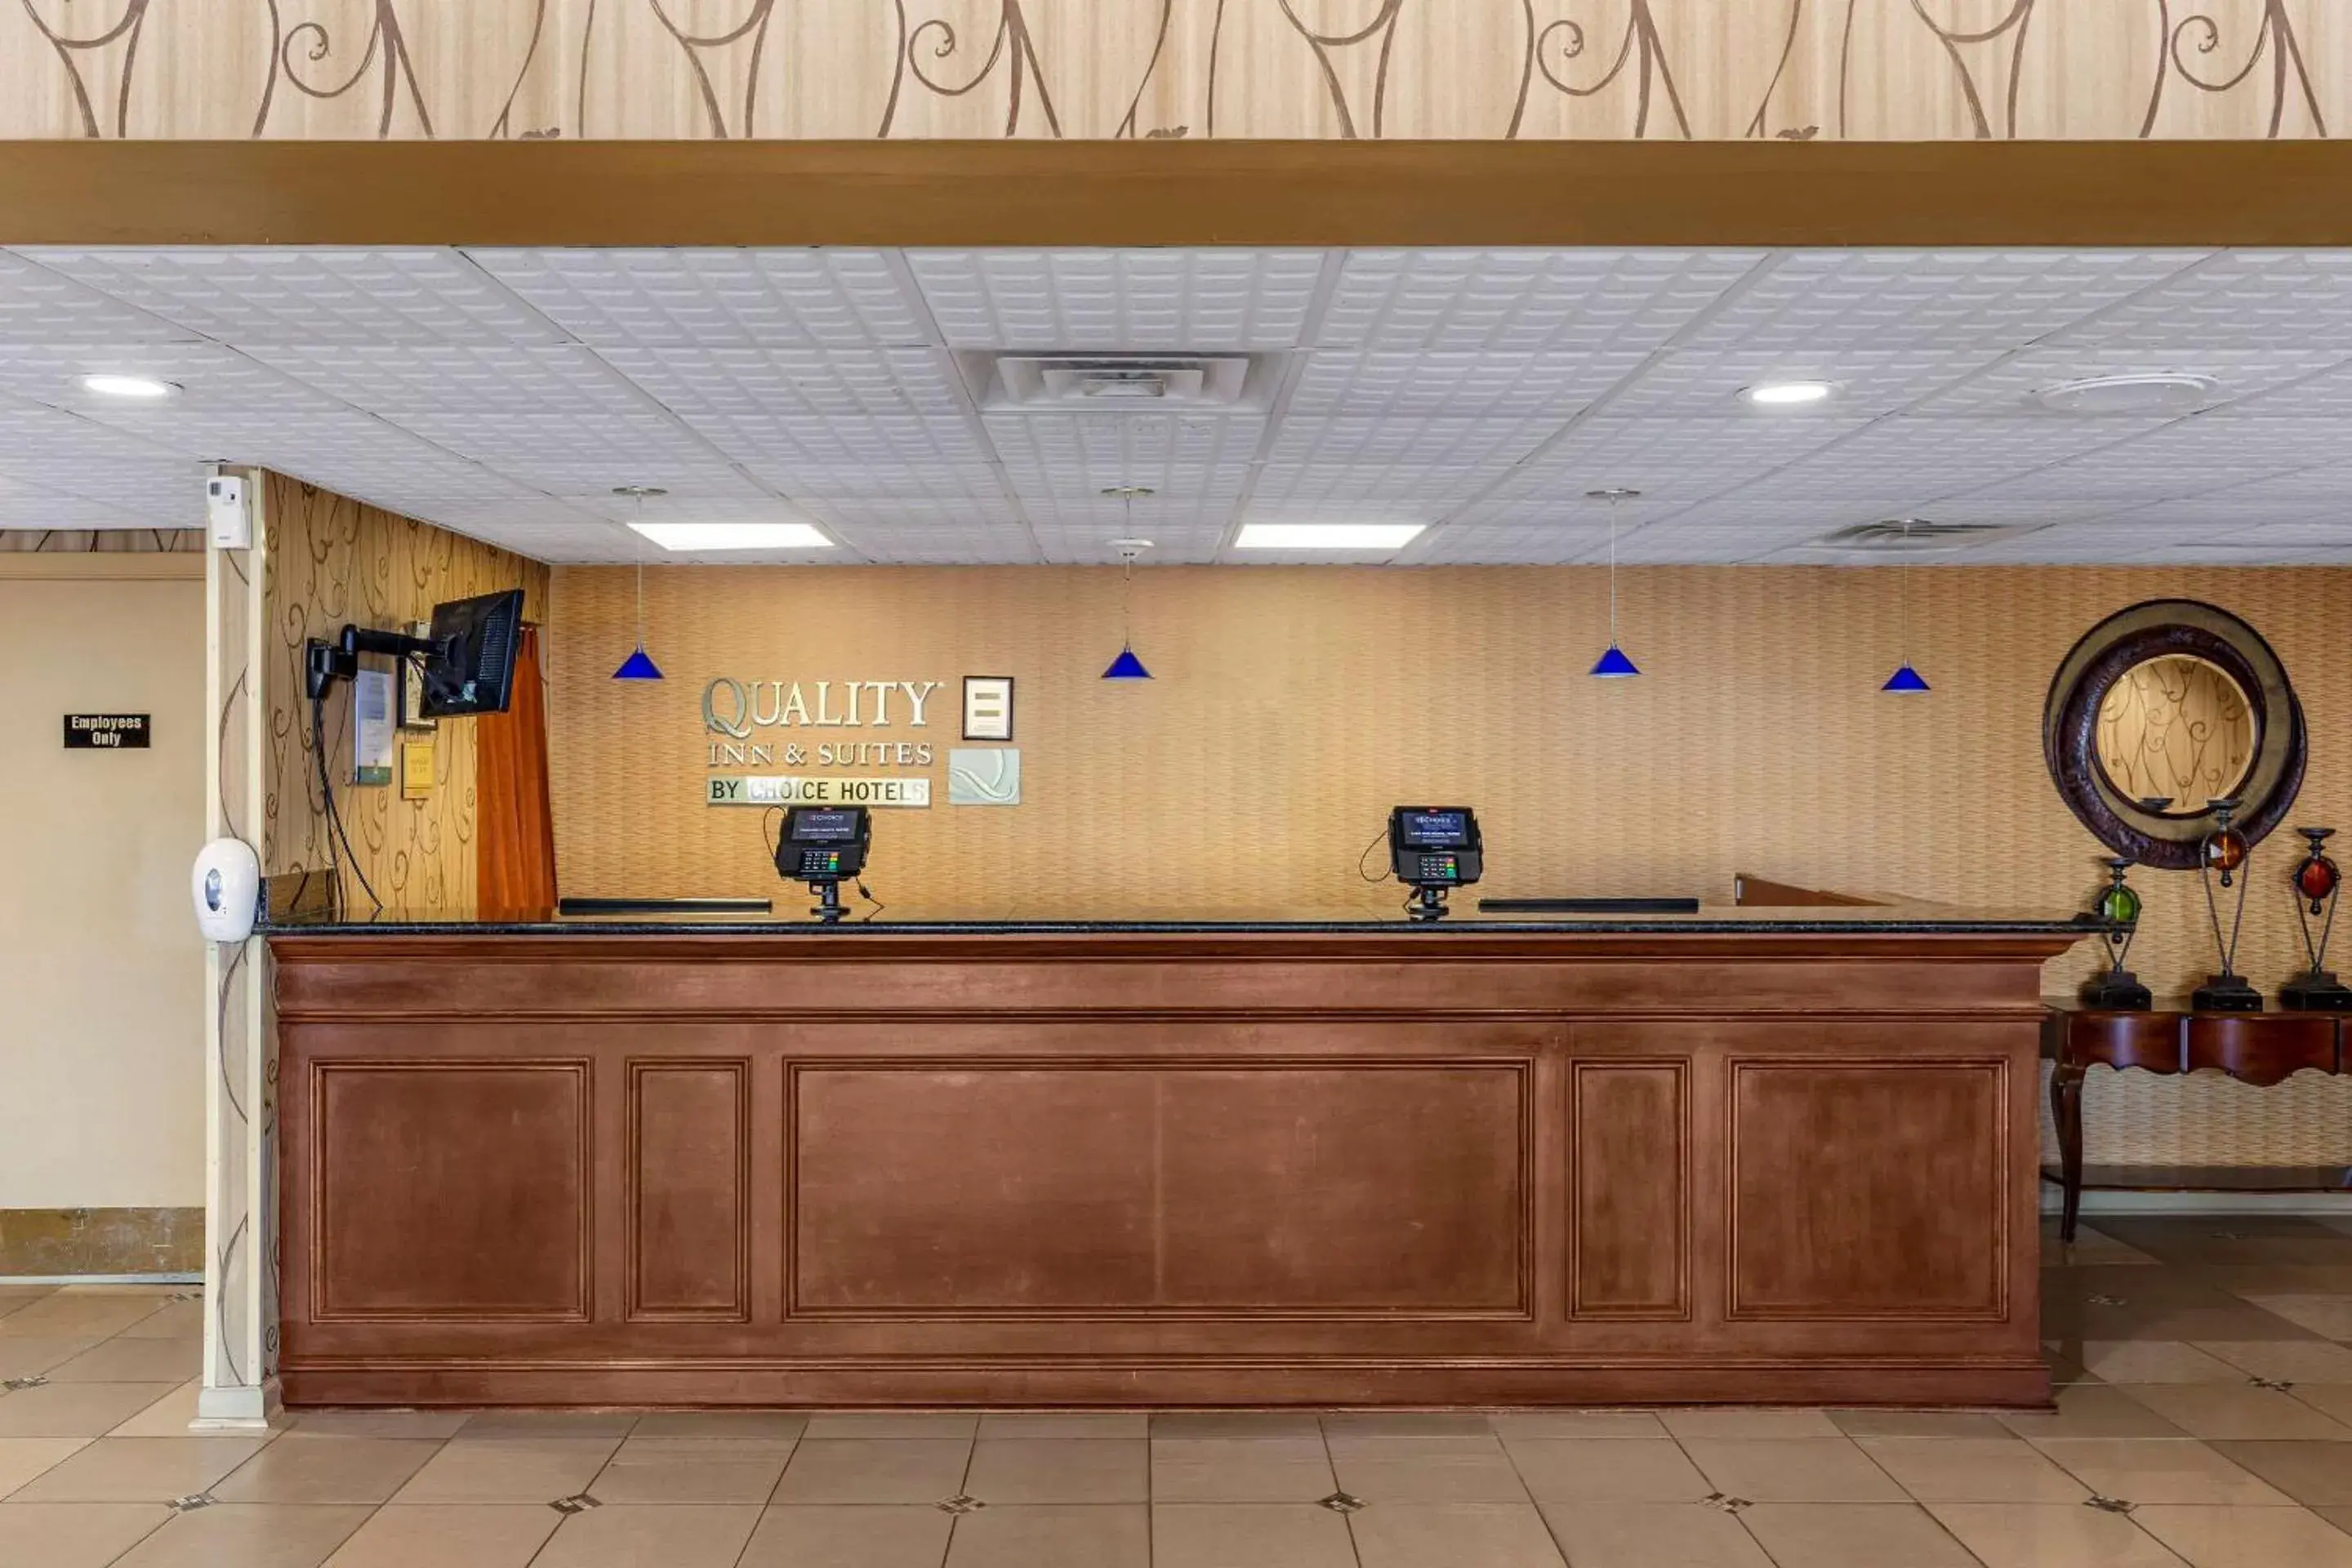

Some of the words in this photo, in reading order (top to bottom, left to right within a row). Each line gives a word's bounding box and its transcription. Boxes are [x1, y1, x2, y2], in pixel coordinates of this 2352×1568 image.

[702, 677, 938, 738] QUALITY
[71, 716, 141, 731] Employees
[92, 732, 121, 746] Only
[707, 742, 774, 766] INN
[785, 742, 807, 766] &
[818, 742, 934, 766] SUITES
[711, 781, 739, 800] BY
[750, 780, 828, 800] CHOICE
[840, 780, 926, 801] HOTELS
